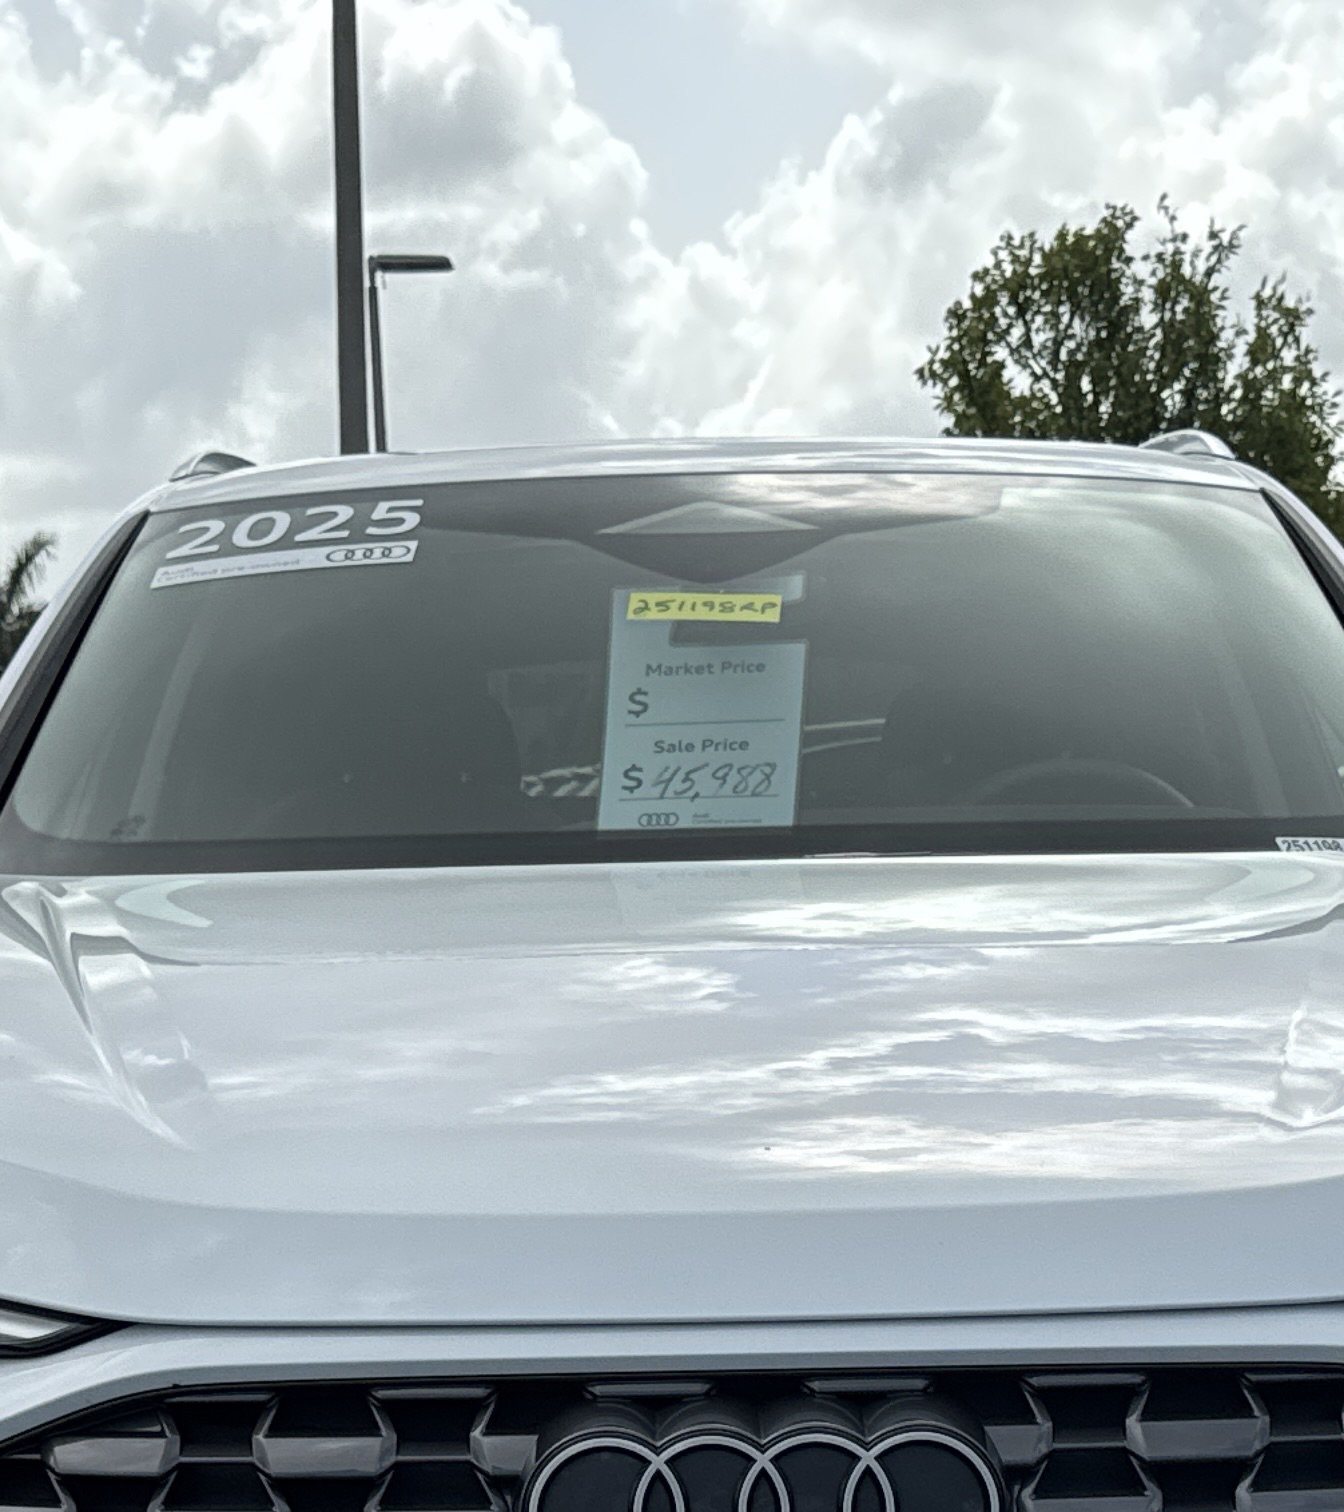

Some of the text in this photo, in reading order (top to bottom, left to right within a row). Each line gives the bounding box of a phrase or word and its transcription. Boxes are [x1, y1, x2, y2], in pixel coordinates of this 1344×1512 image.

[165, 498, 425, 560] 2025
[644, 660, 767, 677] Market Price
[626, 687, 650, 719] $
[653, 738, 750, 755] Sale Price
